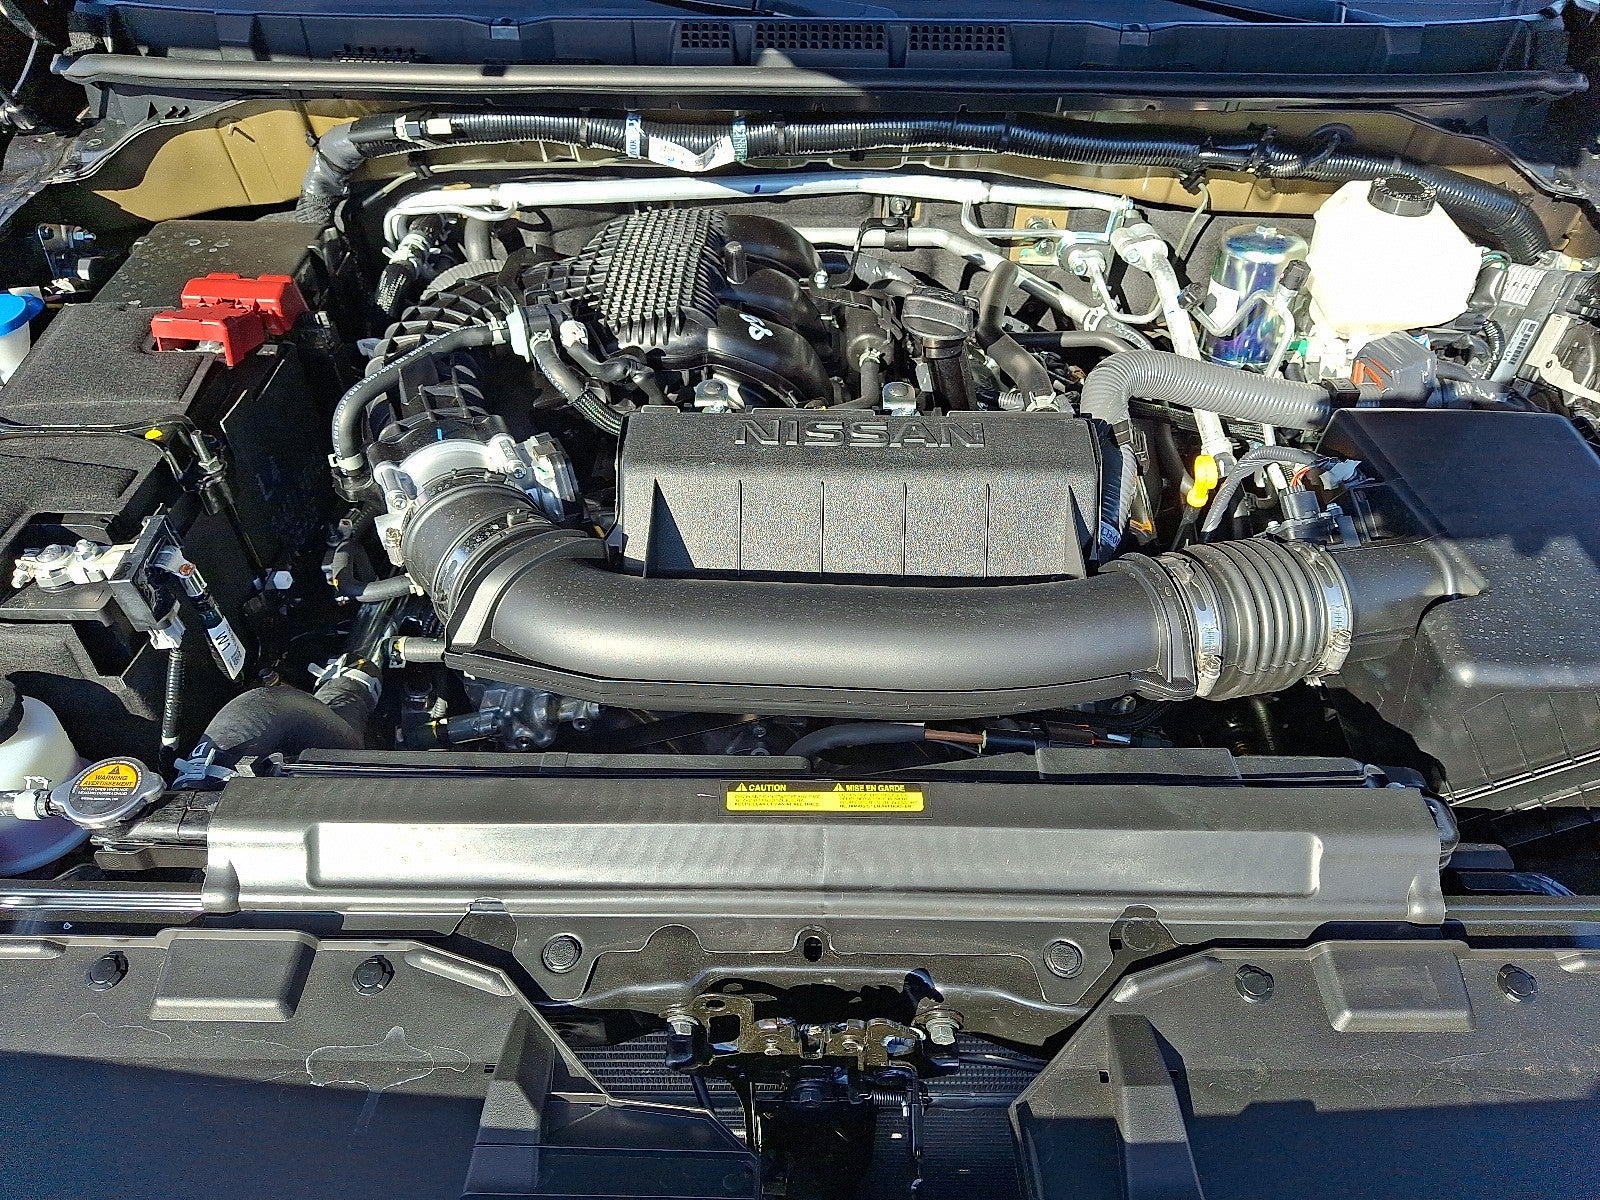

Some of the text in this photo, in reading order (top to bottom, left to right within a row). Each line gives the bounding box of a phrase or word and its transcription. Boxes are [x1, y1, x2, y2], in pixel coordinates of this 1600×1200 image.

[733, 419, 986, 448] NISSAN
[748, 783, 787, 792] CAUTION
[845, 784, 906, 792] MISE EN GARDE
